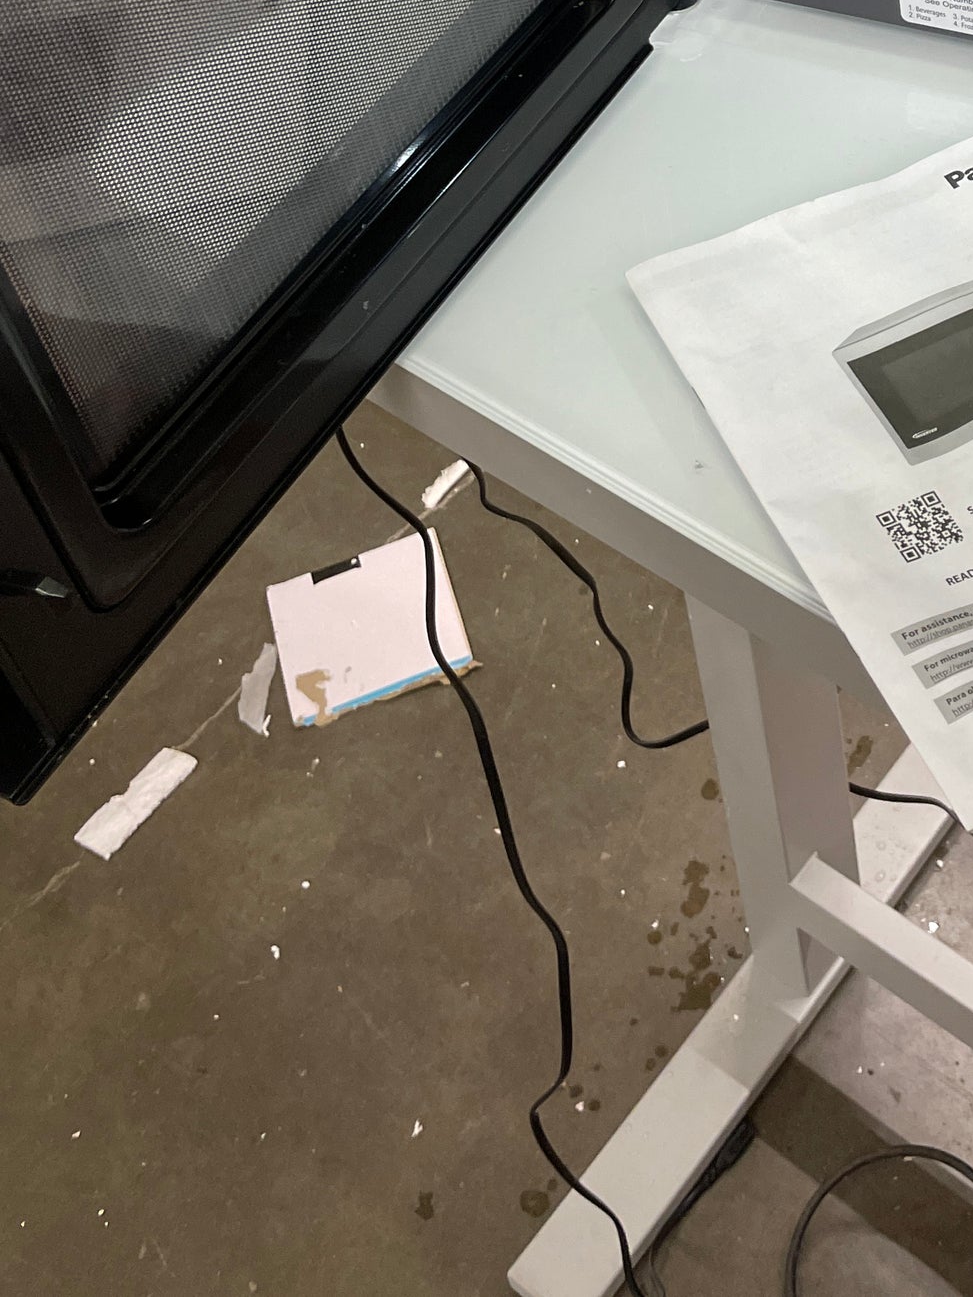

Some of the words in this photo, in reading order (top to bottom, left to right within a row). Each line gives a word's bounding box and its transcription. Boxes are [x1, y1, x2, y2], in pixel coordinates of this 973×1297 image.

[908, 11, 914, 19] 2.
[915, 12, 932, 22] Pizza
[916, 5, 946, 18] Beverages
[900, 629, 919, 641] For
[920, 611, 973, 633] assistance,
